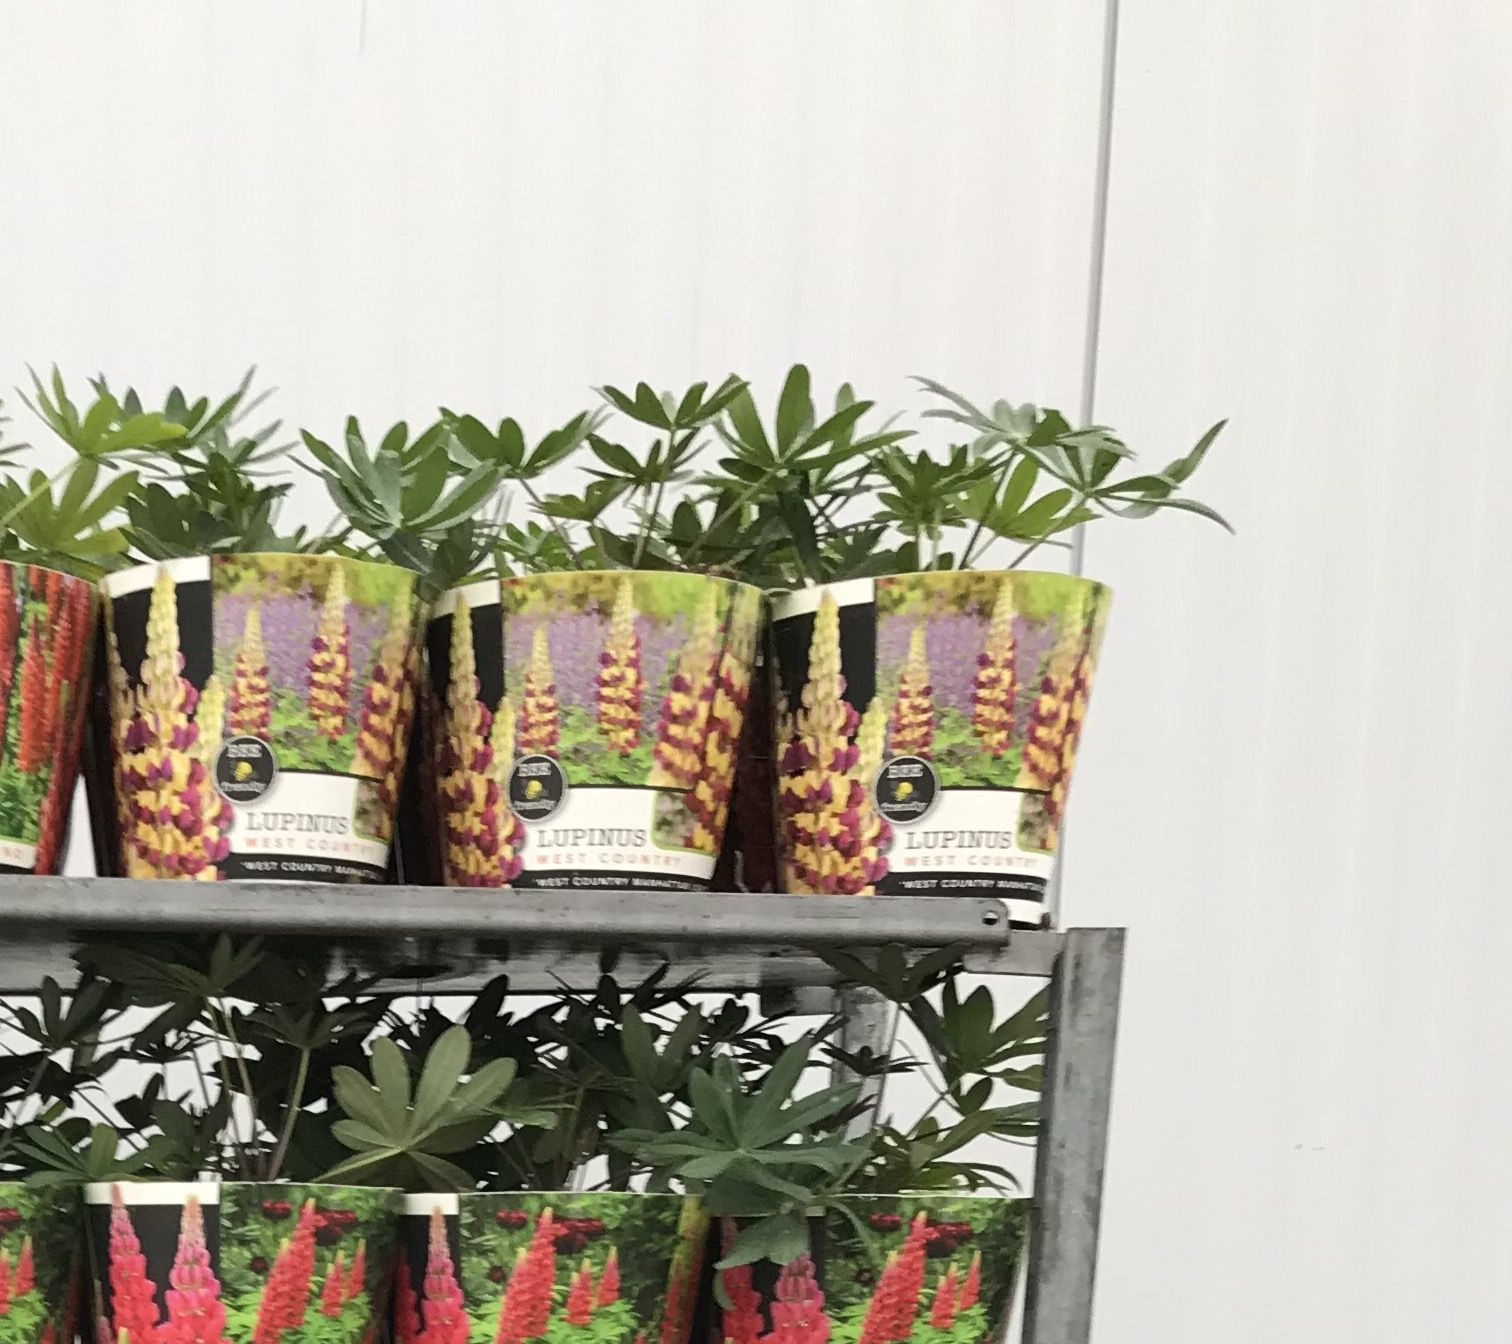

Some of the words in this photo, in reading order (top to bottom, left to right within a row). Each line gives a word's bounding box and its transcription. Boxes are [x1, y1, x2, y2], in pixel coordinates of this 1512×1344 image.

[246, 811, 350, 835] LUPINUS
[244, 837, 295, 849] WEST
[537, 828, 648, 848] LUPINUS
[905, 830, 1013, 849] LUPINUS
[536, 853, 587, 865] WEST
[598, 852, 684, 867] COUNTRY
[904, 856, 955, 866] WEST
